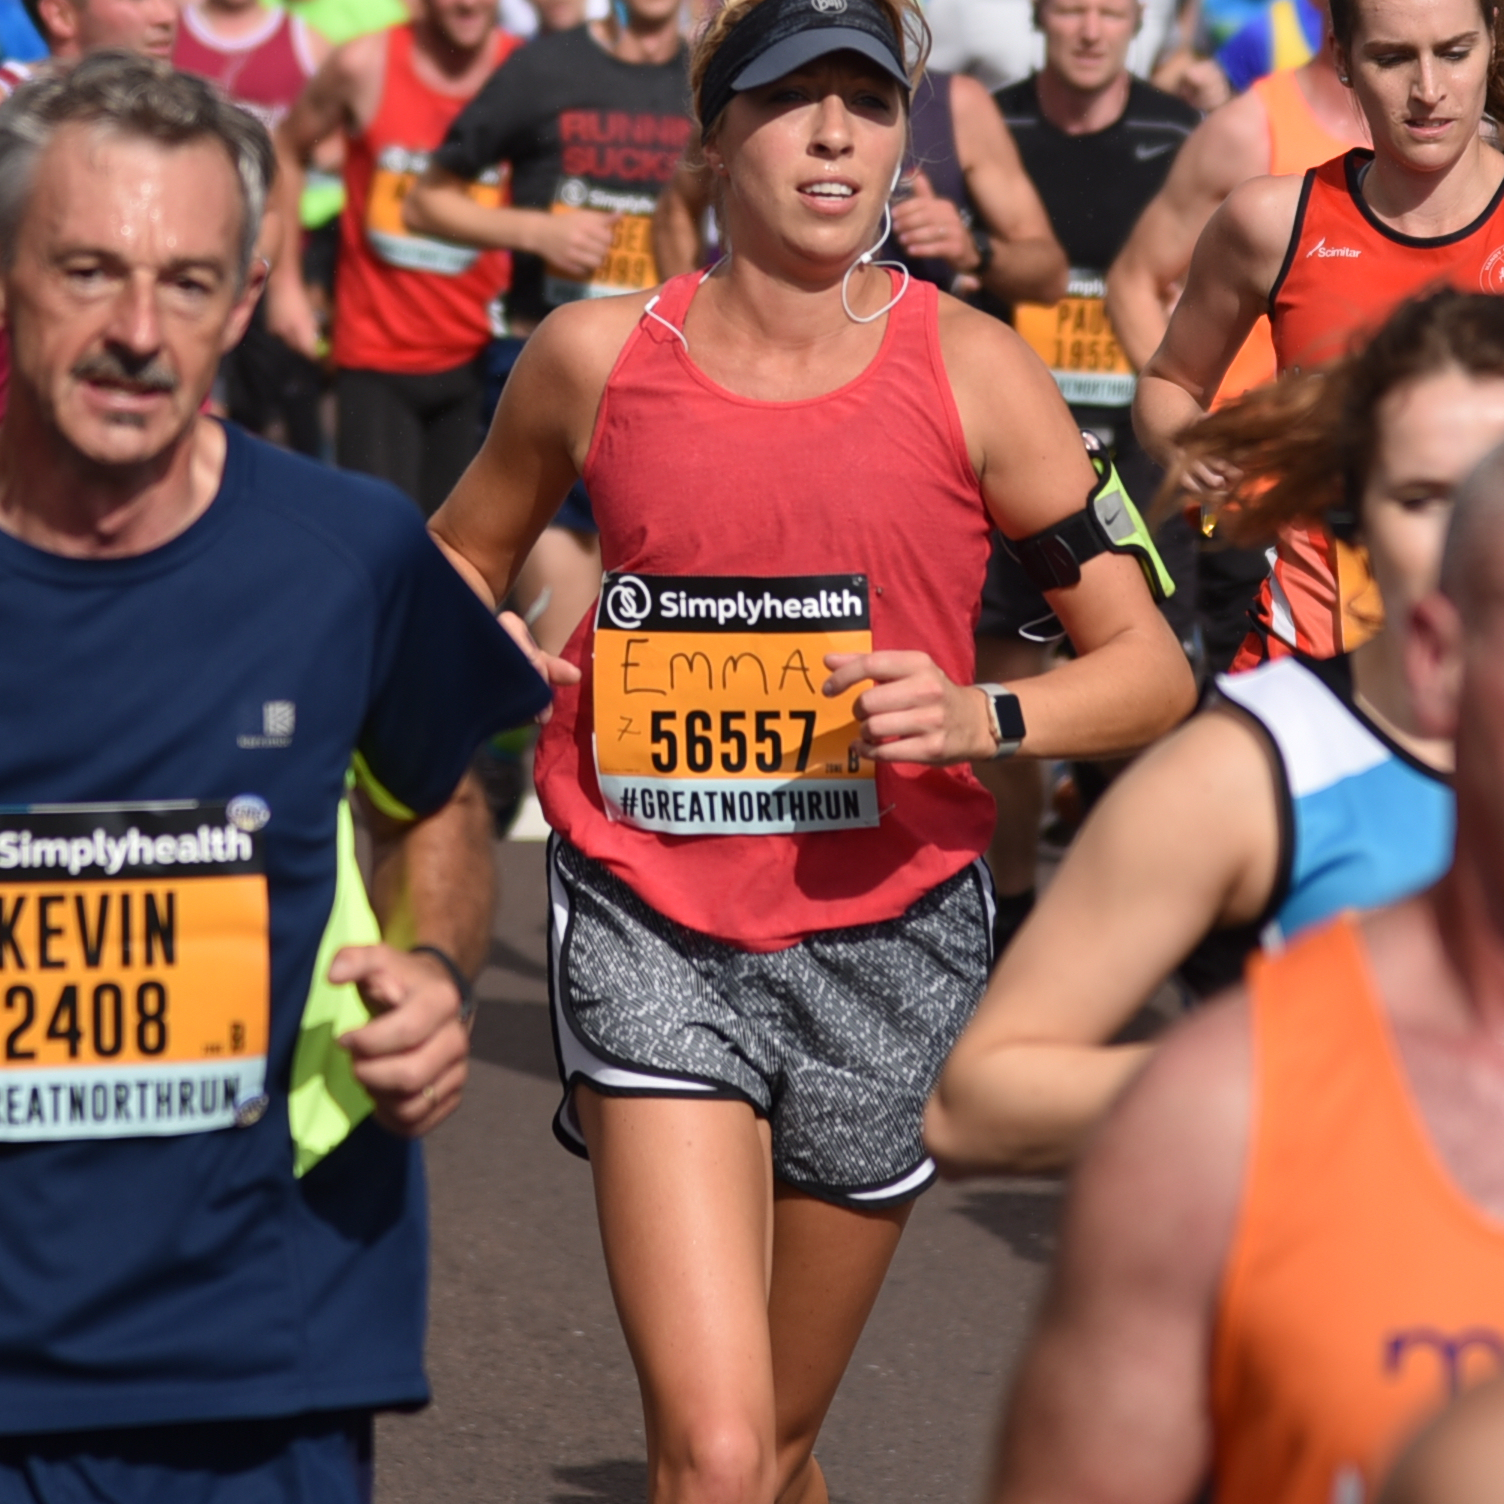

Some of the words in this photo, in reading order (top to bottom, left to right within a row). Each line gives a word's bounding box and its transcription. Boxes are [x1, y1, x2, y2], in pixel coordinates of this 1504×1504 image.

[1317, 246, 1362, 259] Scimitar
[660, 589, 862, 626] Simplyhealth
[650, 710, 817, 774] 56557
[620, 787, 860, 822] #GREATNORTHRUN
[4, 980, 170, 1061] 2408
